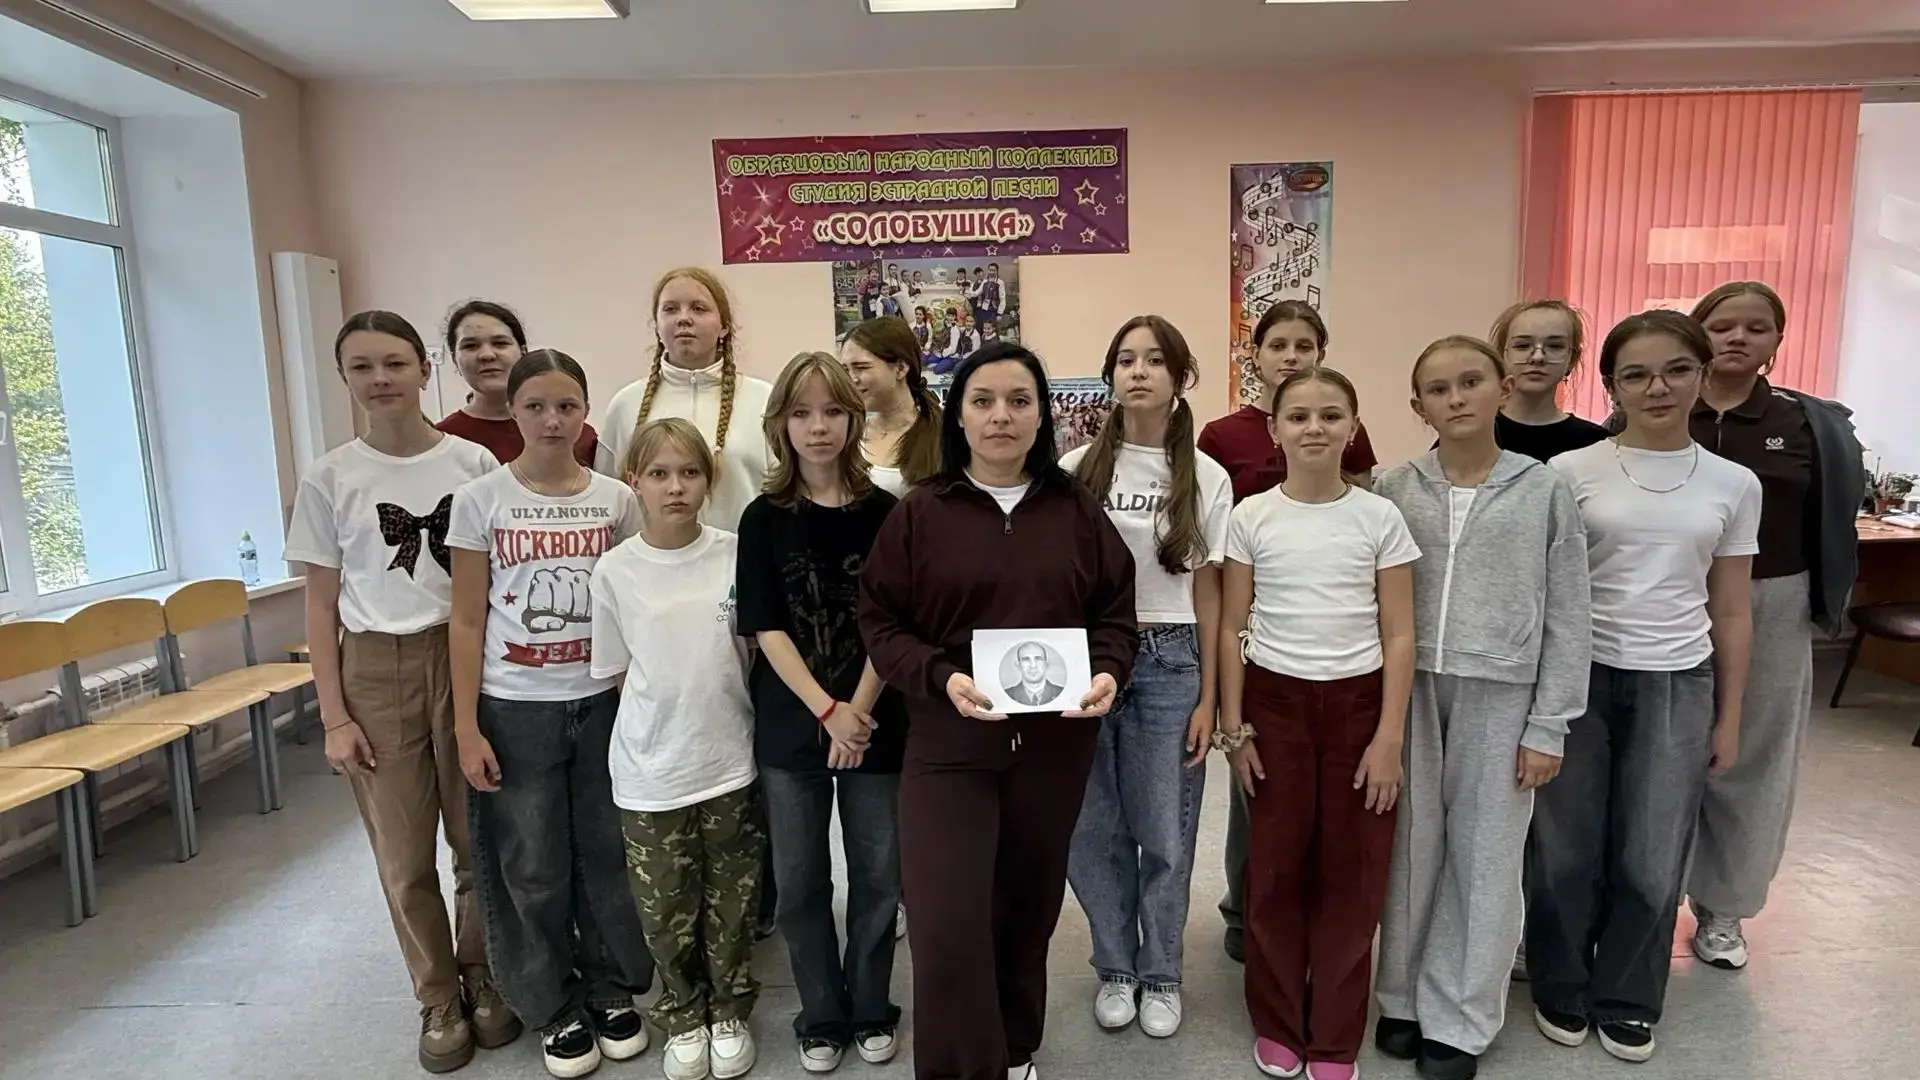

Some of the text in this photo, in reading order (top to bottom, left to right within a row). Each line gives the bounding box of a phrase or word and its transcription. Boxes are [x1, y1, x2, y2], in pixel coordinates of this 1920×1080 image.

[729, 147, 1117, 176] ОБРАЗЦОВЫЙ НАРОДНЫЙ КОЛЛЕКТИВ
[790, 176, 1058, 203] СТУДИЯ ЭСТРАДНОЙ ПЕСНИ
[815, 210, 1033, 243] «СОЛОВУШКА»
[511, 507, 610, 519] ULYANOVSK
